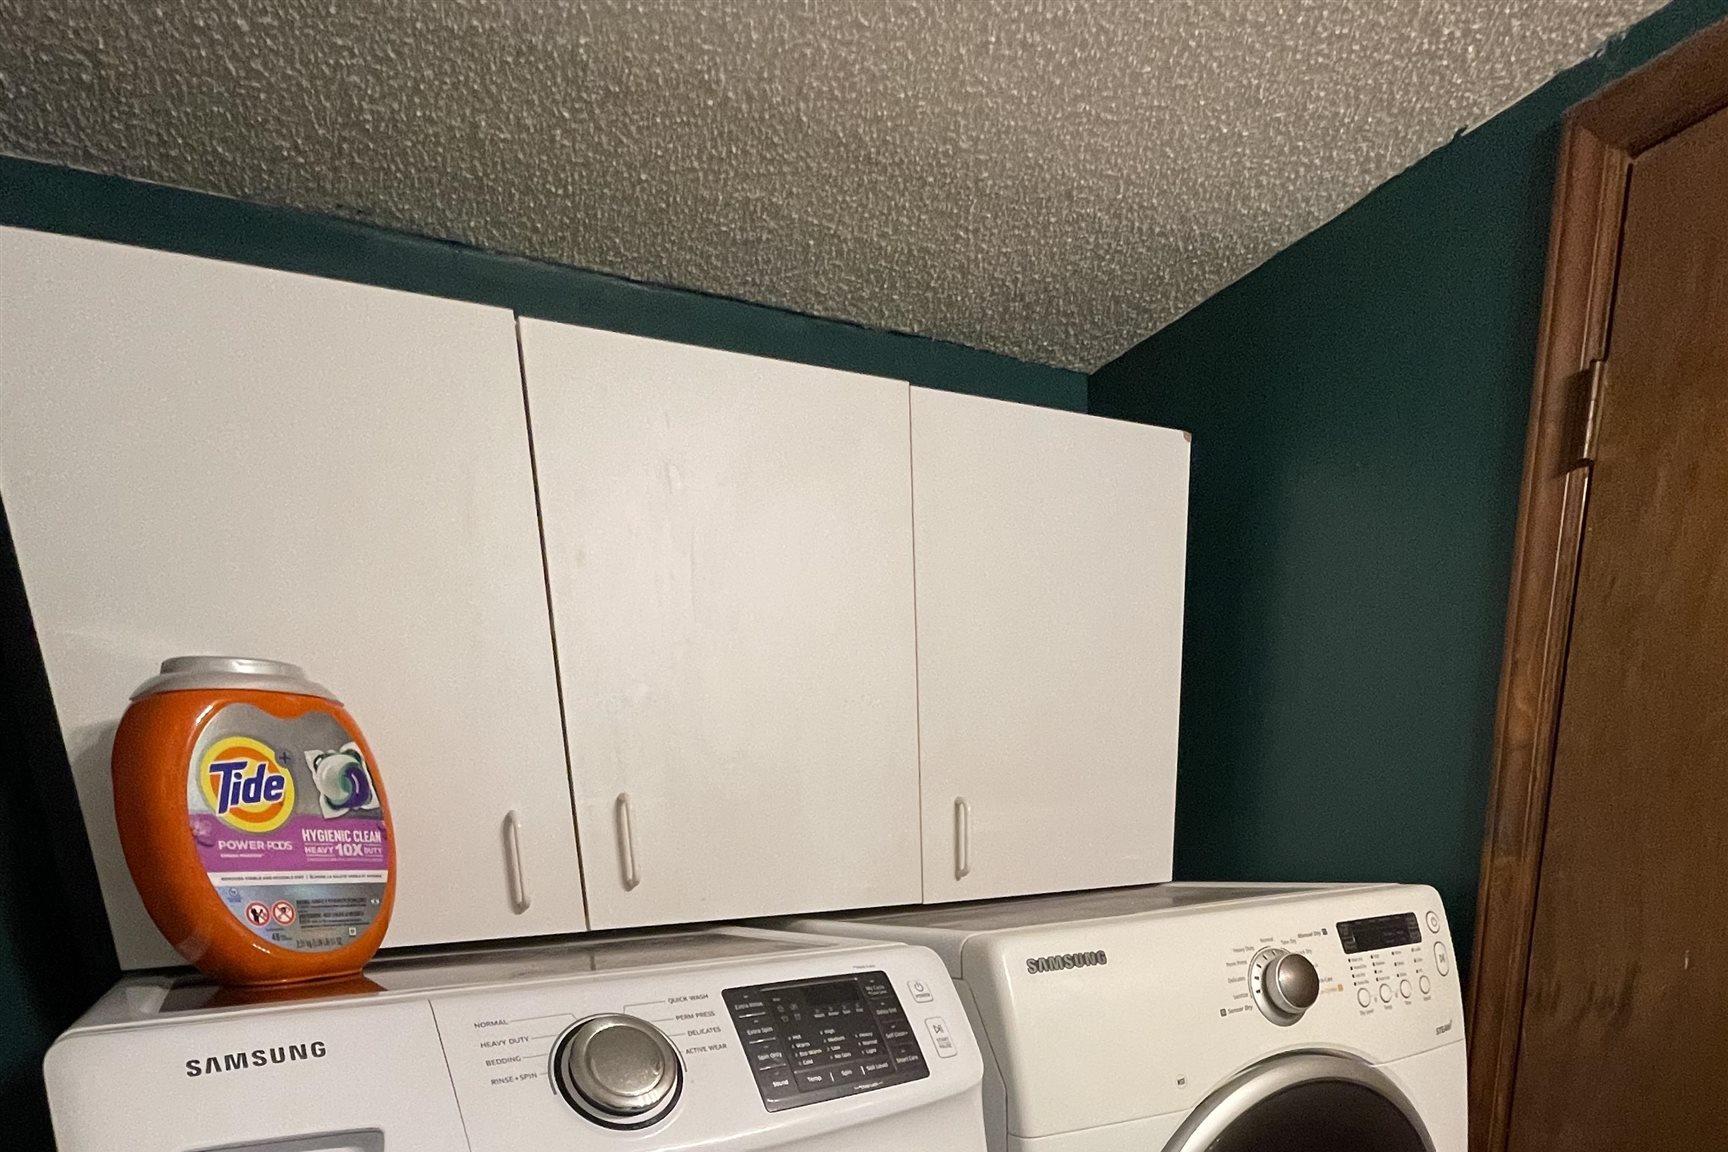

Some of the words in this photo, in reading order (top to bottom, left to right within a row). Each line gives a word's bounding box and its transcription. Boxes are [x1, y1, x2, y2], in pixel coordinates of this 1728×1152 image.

[208, 760, 286, 815] Tide
[302, 828, 351, 842] HYGIENIC
[353, 829, 381, 843] CLEAN
[218, 840, 266, 850] POWER
[304, 846, 333, 855] HEAVY
[335, 843, 364, 857] 10X
[1026, 949, 1107, 974] SAMSUNG
[667, 995, 687, 1004] QUICK
[687, 993, 709, 1002] WASH
[1244, 1004, 1253, 1012] Dry
[675, 1012, 696, 1022] PERM
[697, 1010, 716, 1019] PRESS
[473, 1018, 509, 1030] NORMAL
[687, 1026, 722, 1037] DELICATES
[480, 1038, 507, 1049] HEAVY
[508, 1035, 530, 1046] DUTY
[685, 1046, 708, 1055] ACTIVE
[707, 1043, 728, 1053] WEAR
[185, 1041, 327, 1078] SAMSUNG
[485, 1055, 522, 1068] BEDDING
[490, 1075, 514, 1087] RINSE
[519, 1072, 538, 1082] SPIN
